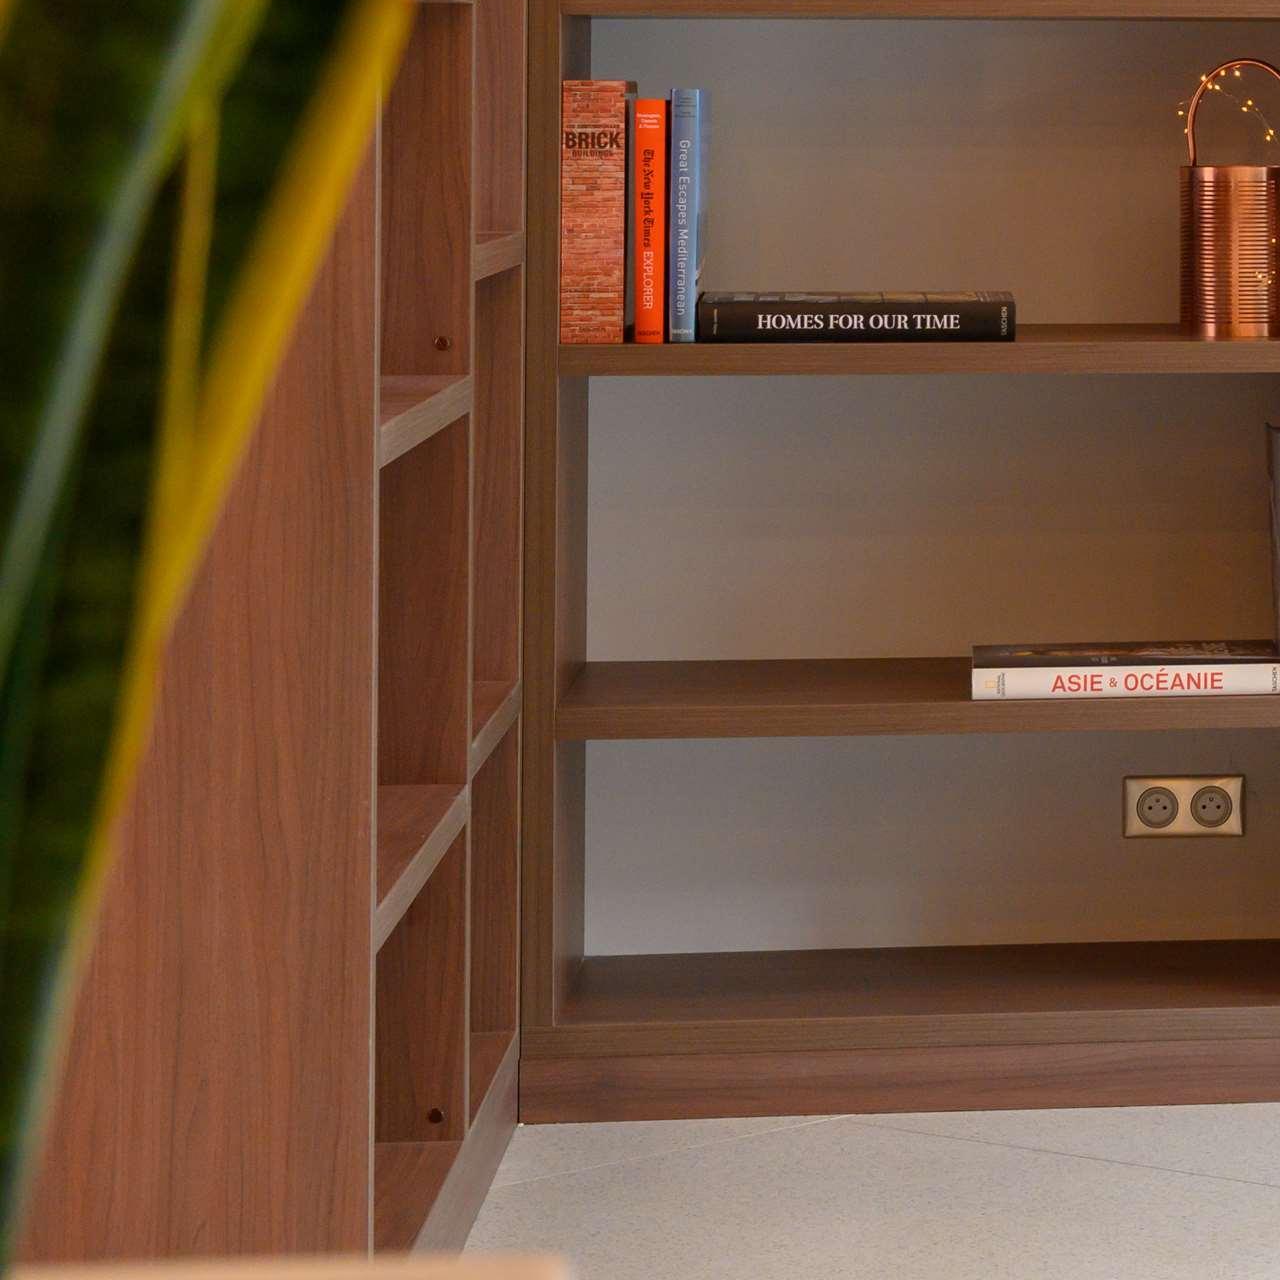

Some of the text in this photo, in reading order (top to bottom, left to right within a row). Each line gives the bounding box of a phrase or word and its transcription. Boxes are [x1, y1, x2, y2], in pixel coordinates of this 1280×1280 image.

[564, 131, 622, 149] BRICK
[641, 149, 655, 310] The New York Times EXPLORER
[676, 140, 691, 316] Great Escapes Mediterranean
[756, 314, 961, 330] HOMES FOR OUR TIME
[1051, 667, 1224, 693] ASIE & OCÉANIE
